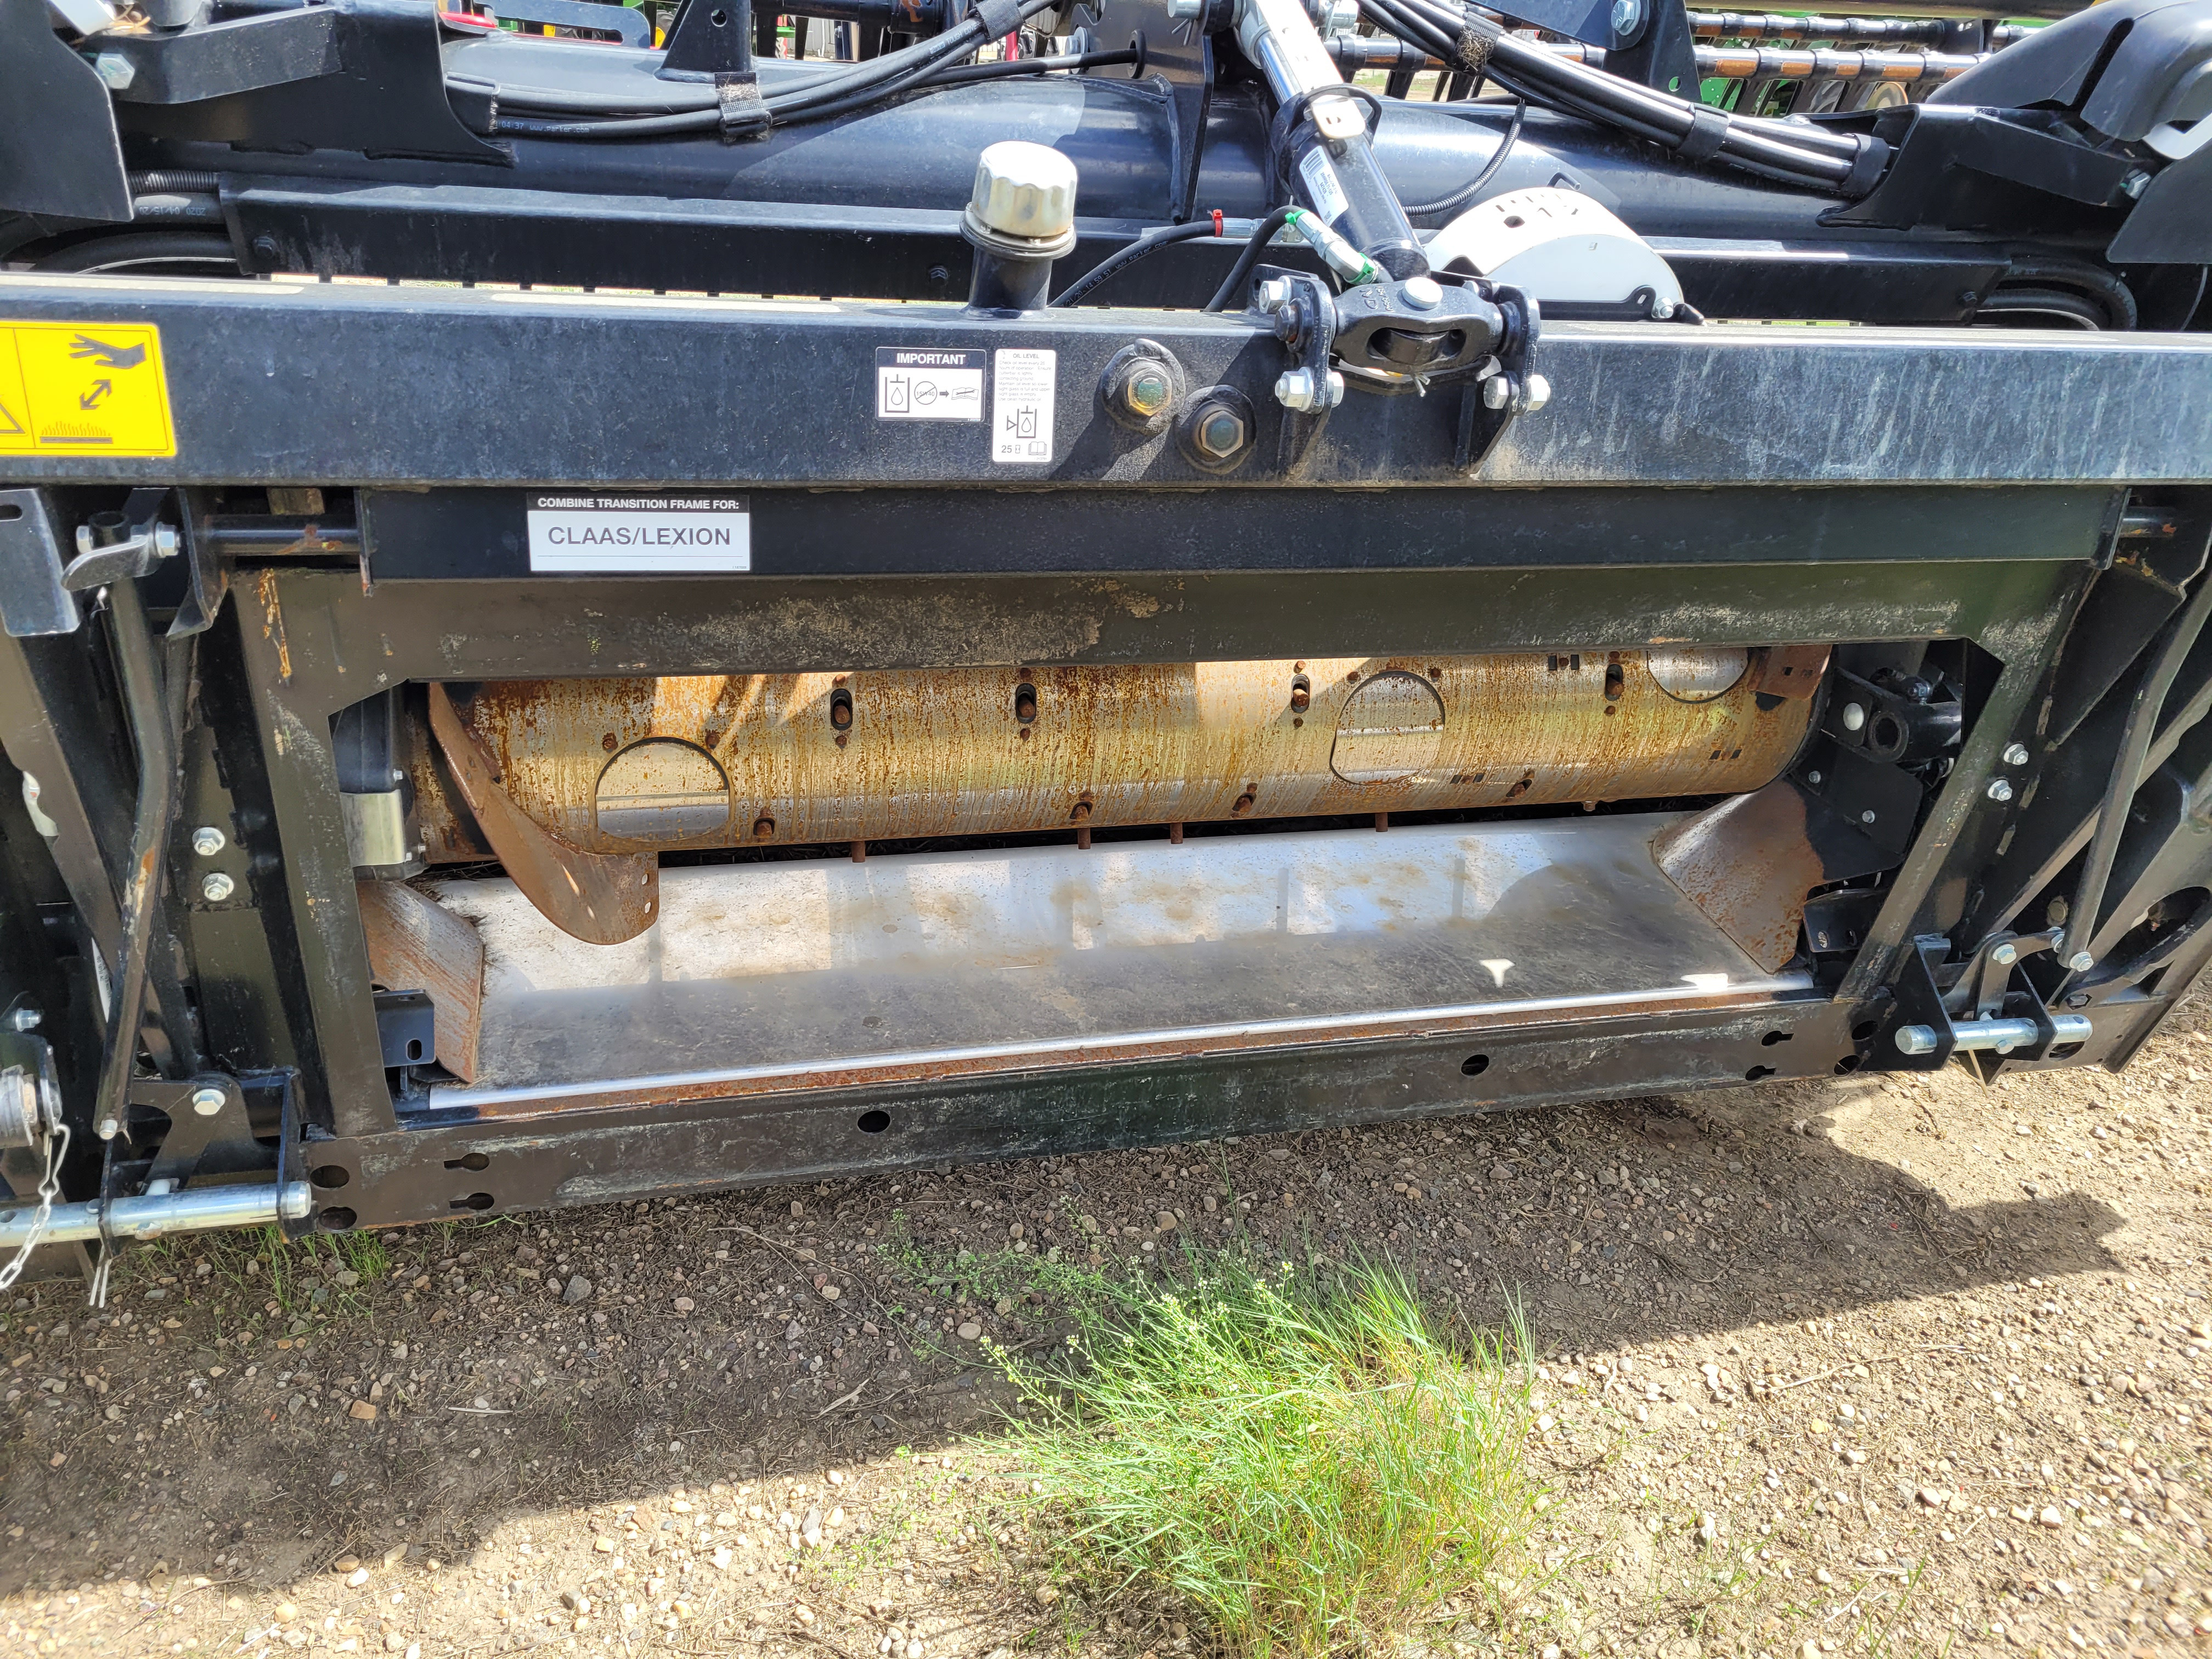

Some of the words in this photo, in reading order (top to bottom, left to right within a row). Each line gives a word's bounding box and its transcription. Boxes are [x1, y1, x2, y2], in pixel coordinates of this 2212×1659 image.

[896, 353, 966, 365] IMPORTANT
[1001, 445, 1012, 453] 25
[538, 498, 594, 508] COMBINE
[596, 499, 668, 509] TRANSITION
[670, 499, 710, 509] FRAME
[713, 500, 739, 510] FOR:
[548, 526, 731, 545] CLAAS/LEXION
